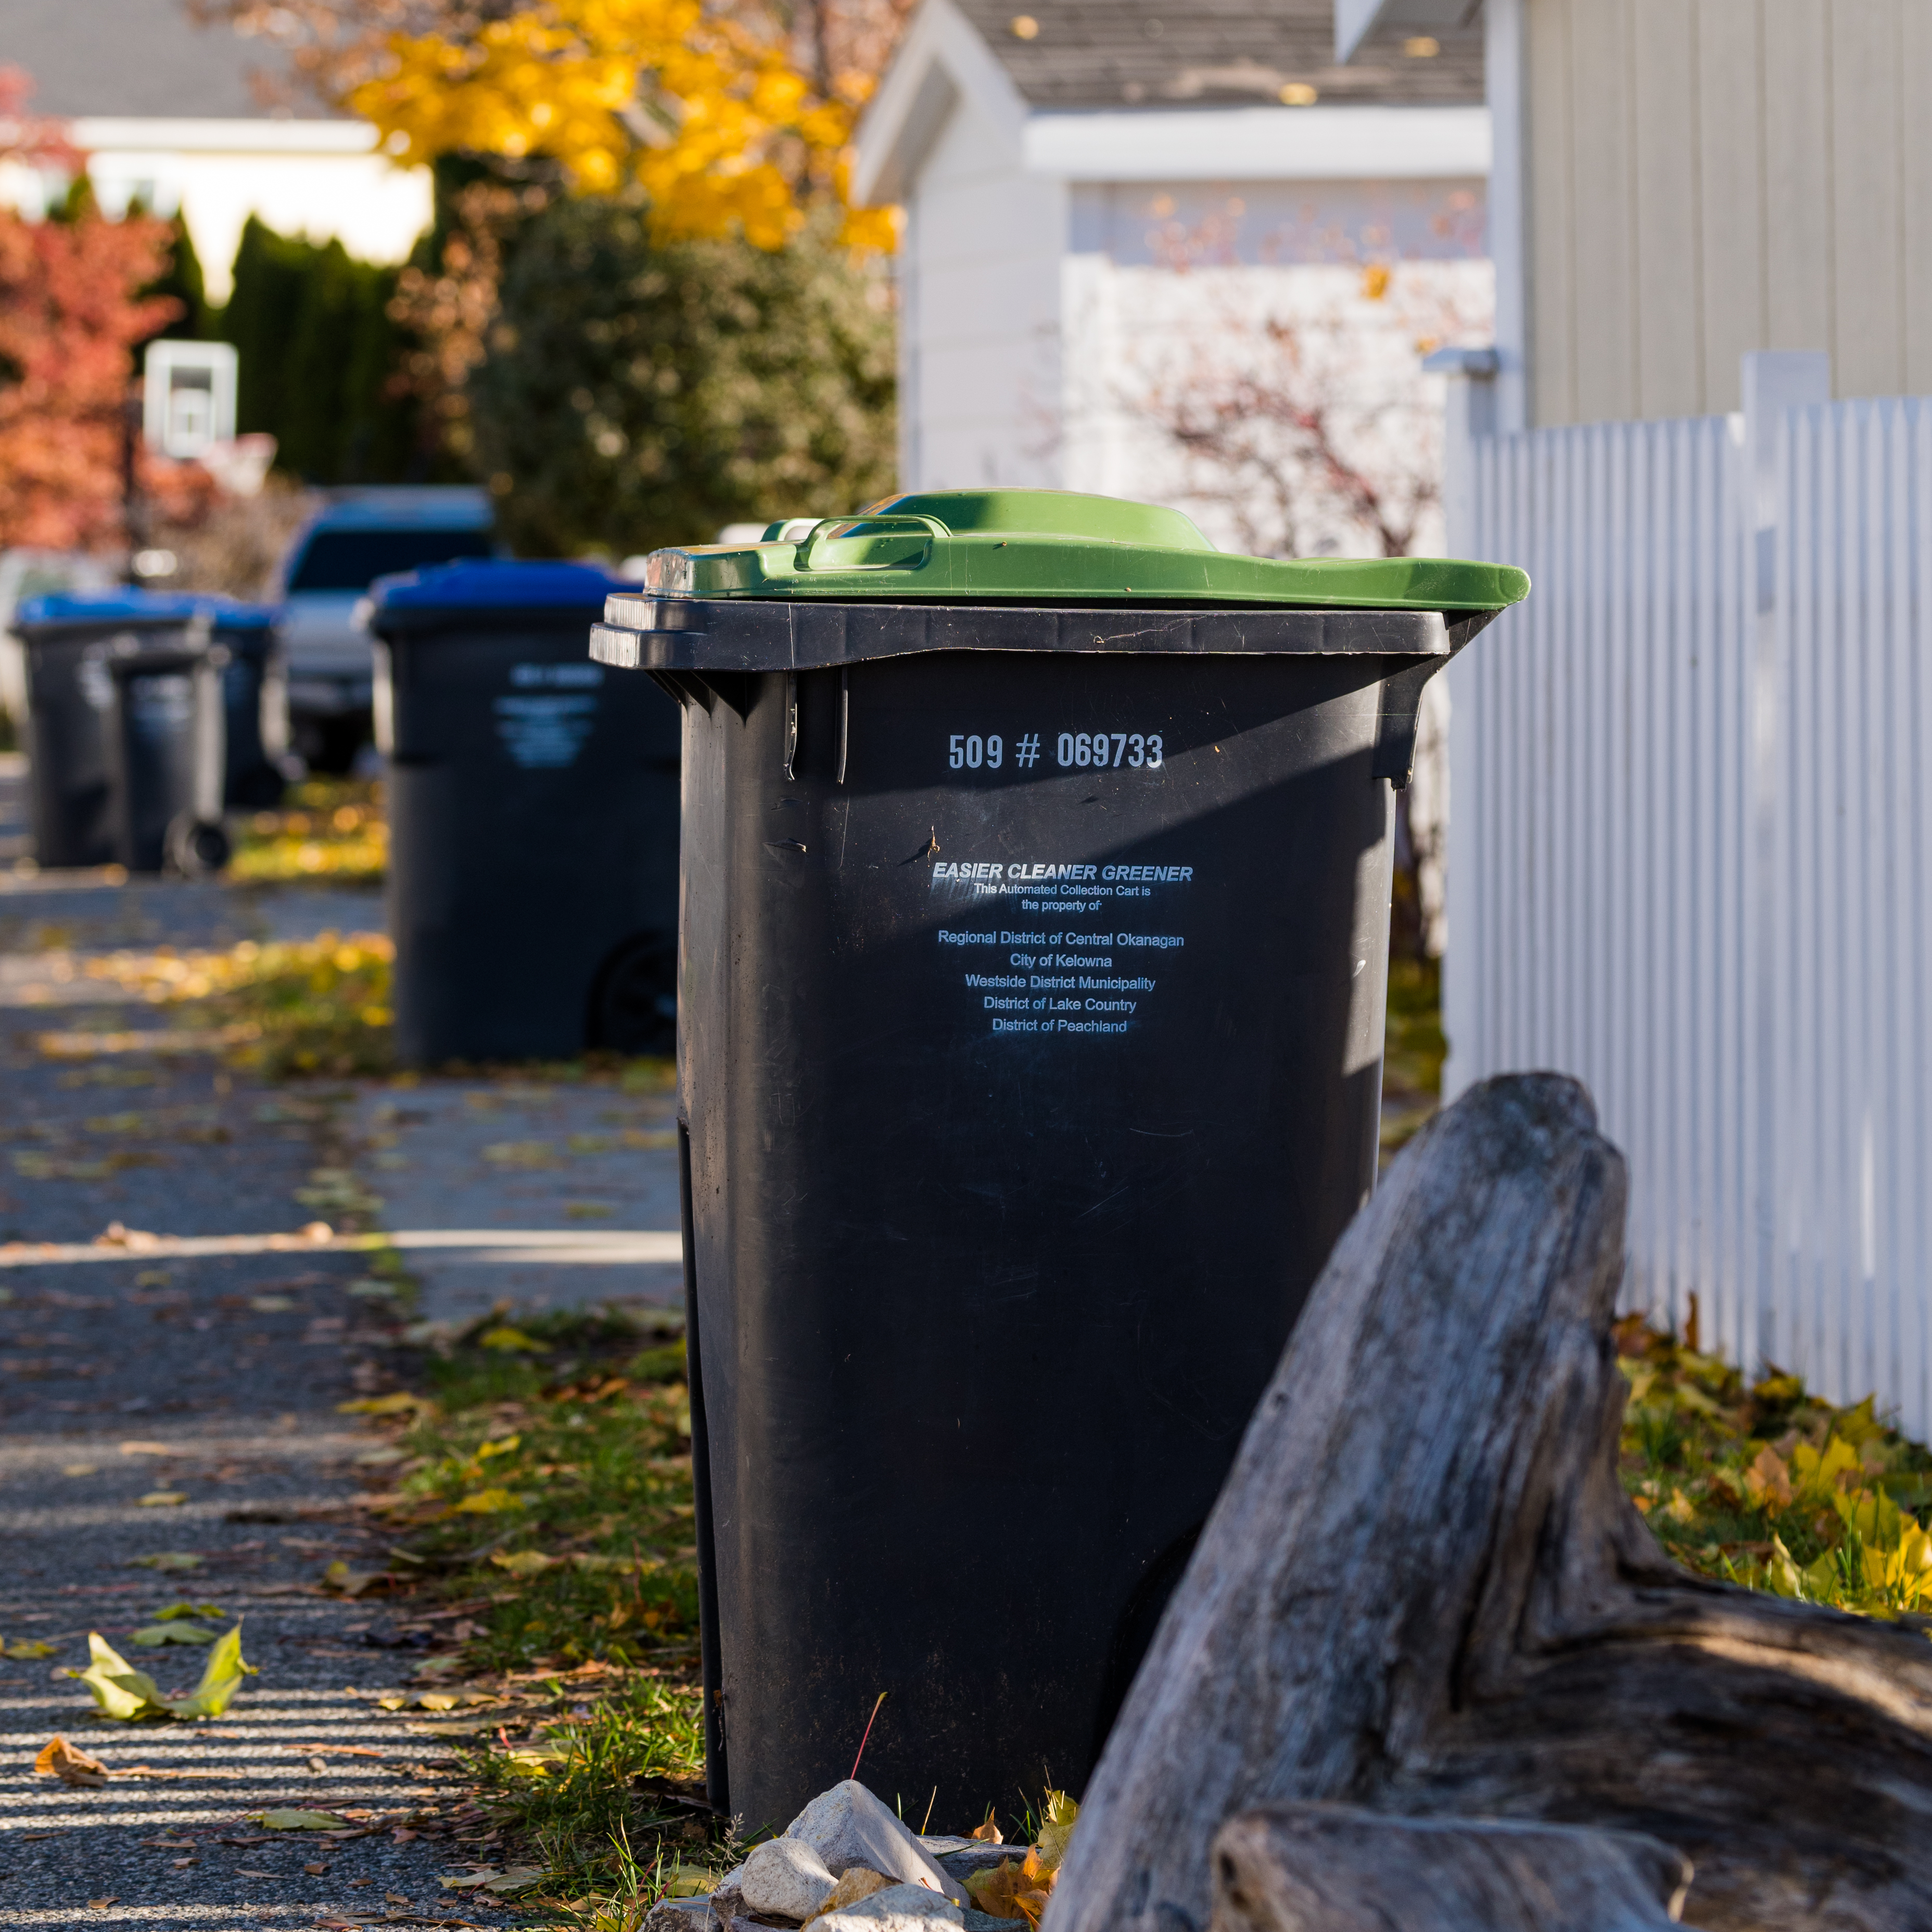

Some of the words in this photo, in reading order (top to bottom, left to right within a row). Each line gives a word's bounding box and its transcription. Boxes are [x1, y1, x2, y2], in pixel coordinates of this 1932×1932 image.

[949, 735, 1002, 768] 509
[1016, 734, 1040, 768] #
[1058, 733, 1163, 768] 069733
[933, 862, 1003, 879] EASIER
[1008, 863, 1096, 880] CLEANER
[1102, 866, 1193, 881] GREENER
[974, 884, 997, 894] This
[999, 884, 1057, 895] Automated
[1060, 885, 1112, 895] Collection
[1115, 886, 1139, 896] Cart
[1141, 886, 1150, 896] is
[1022, 899, 1039, 909] the
[1041, 900, 1086, 912] property
[938, 930, 996, 945] Regional
[1000, 932, 1045, 944] District
[1049, 932, 1062, 945] of
[1066, 933, 1113, 945] Central
[1117, 933, 1184, 948] Okanagan
[1010, 954, 1036, 968] City
[1039, 954, 1053, 966] of
[1056, 955, 1112, 967] Kelowna
[965, 974, 1026, 987] Westside
[1030, 975, 1075, 988] District
[1079, 976, 1155, 991] Municipality
[984, 997, 1029, 1009] District
[1033, 997, 1046, 1009] of
[1050, 998, 1081, 1010] Lake
[1085, 998, 1136, 1013] Country
[993, 1019, 1037, 1031] District
[1041, 1020, 1054, 1031] of
[1058, 1020, 1127, 1033] Peachland
